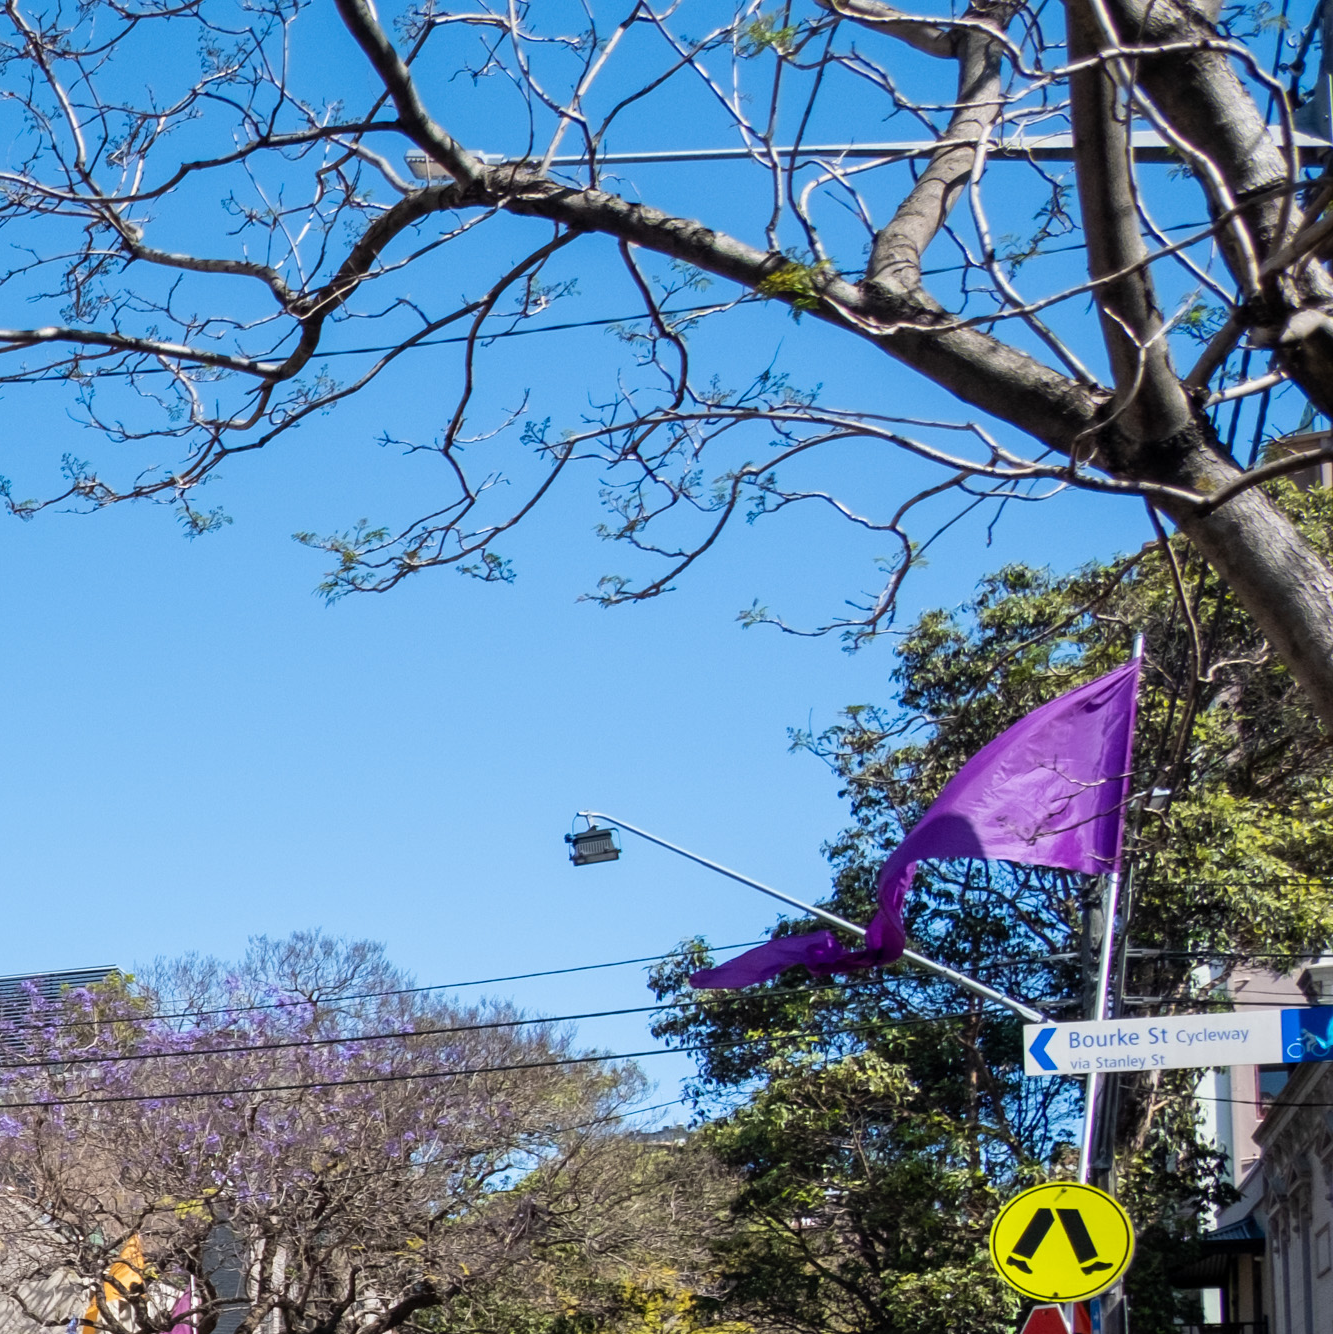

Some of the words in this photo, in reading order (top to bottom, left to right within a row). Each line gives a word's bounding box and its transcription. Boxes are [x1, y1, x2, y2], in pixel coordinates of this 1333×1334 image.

[1068, 1029, 1139, 1049] Bourke
[1148, 1027, 1168, 1045] St
[1176, 1027, 1249, 1046] Cycleway
[1070, 1058, 1090, 1070] via
[1096, 1055, 1146, 1070] Stanley
[1151, 1054, 1166, 1066] St
